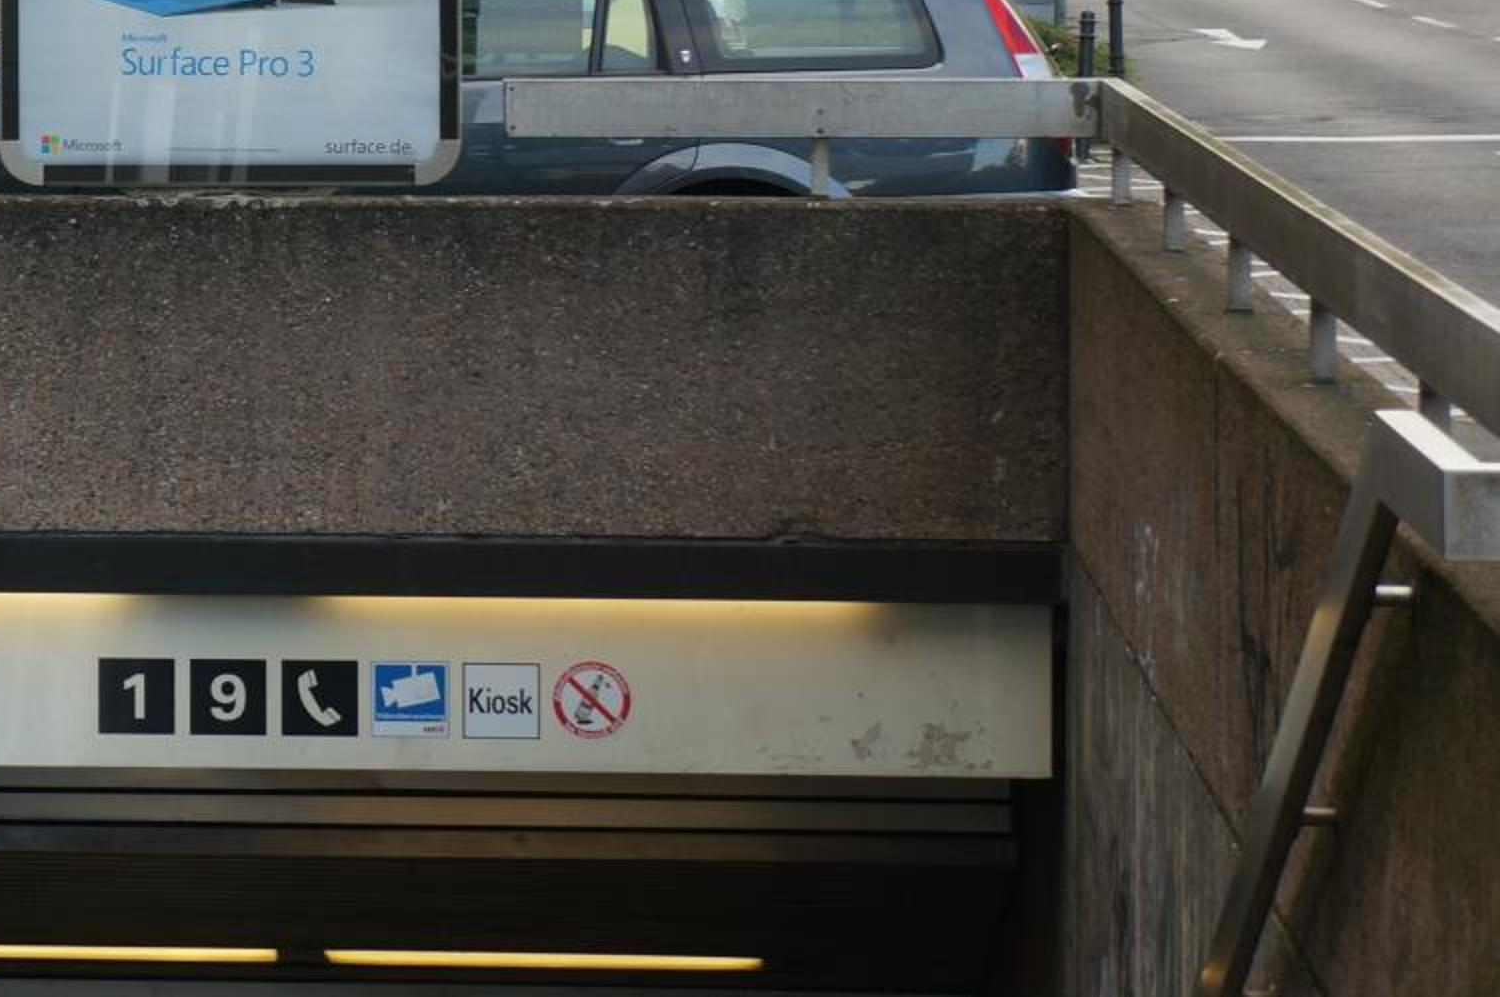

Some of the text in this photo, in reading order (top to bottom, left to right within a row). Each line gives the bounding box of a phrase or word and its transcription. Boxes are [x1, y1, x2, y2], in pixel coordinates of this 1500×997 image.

[121, 46, 315, 78] Surface Pro 3
[63, 139, 122, 153] Microsoft
[324, 138, 412, 156] surface.de
[123, 672, 146, 720] 1
[210, 673, 247, 722] 9
[468, 686, 533, 715] Kiosk
